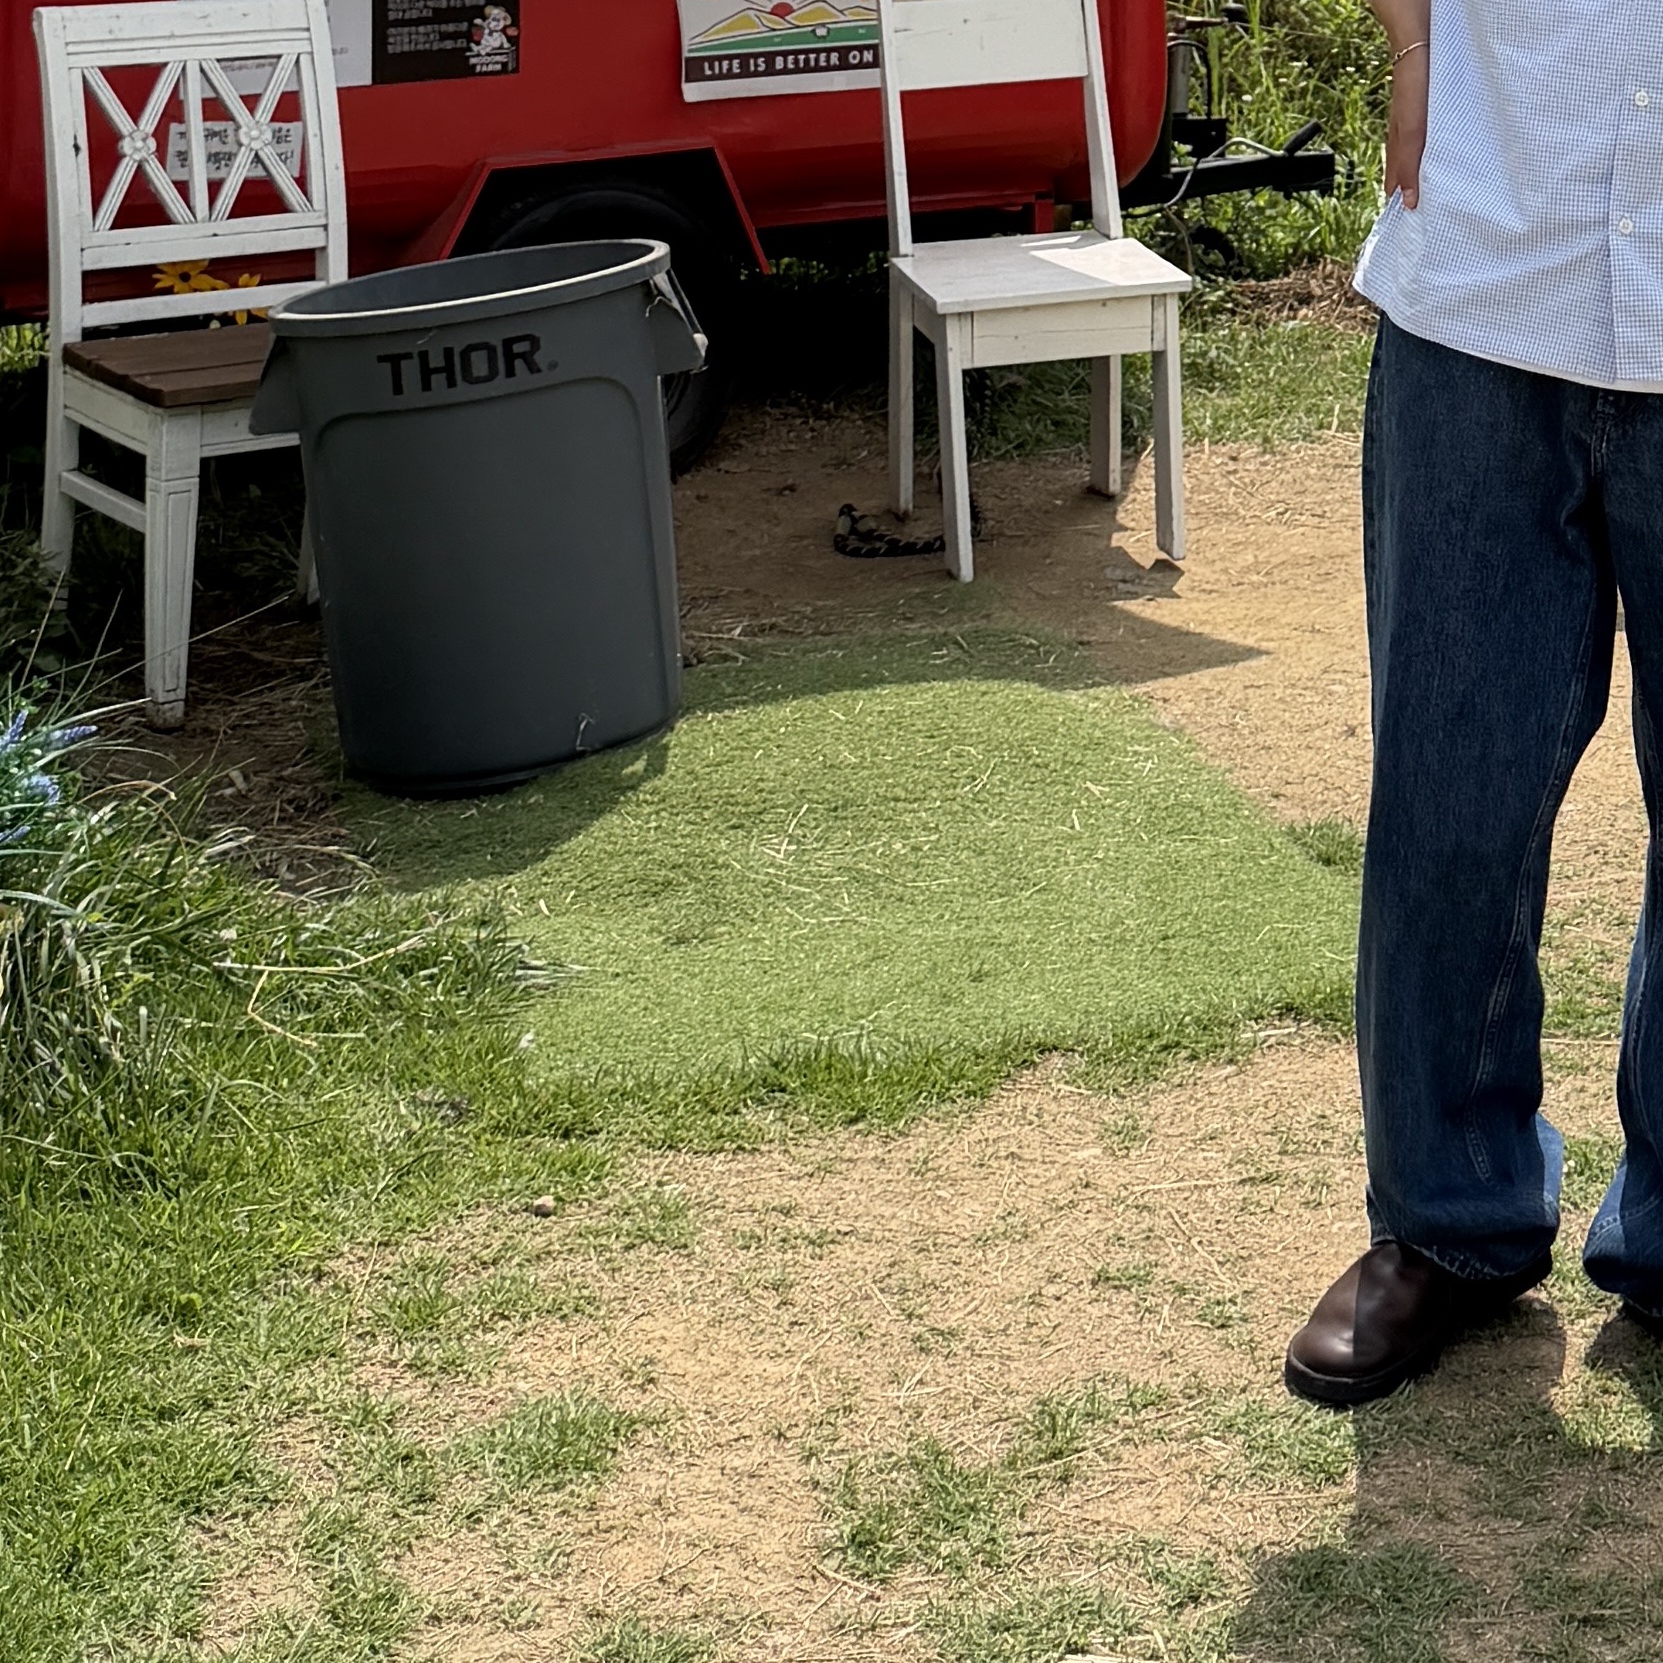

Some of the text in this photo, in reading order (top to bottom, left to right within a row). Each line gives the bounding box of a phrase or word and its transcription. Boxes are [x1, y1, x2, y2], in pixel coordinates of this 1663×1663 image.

[703, 49, 874, 75] LIFE IS BETTER ON
[376, 333, 543, 396] THOR
